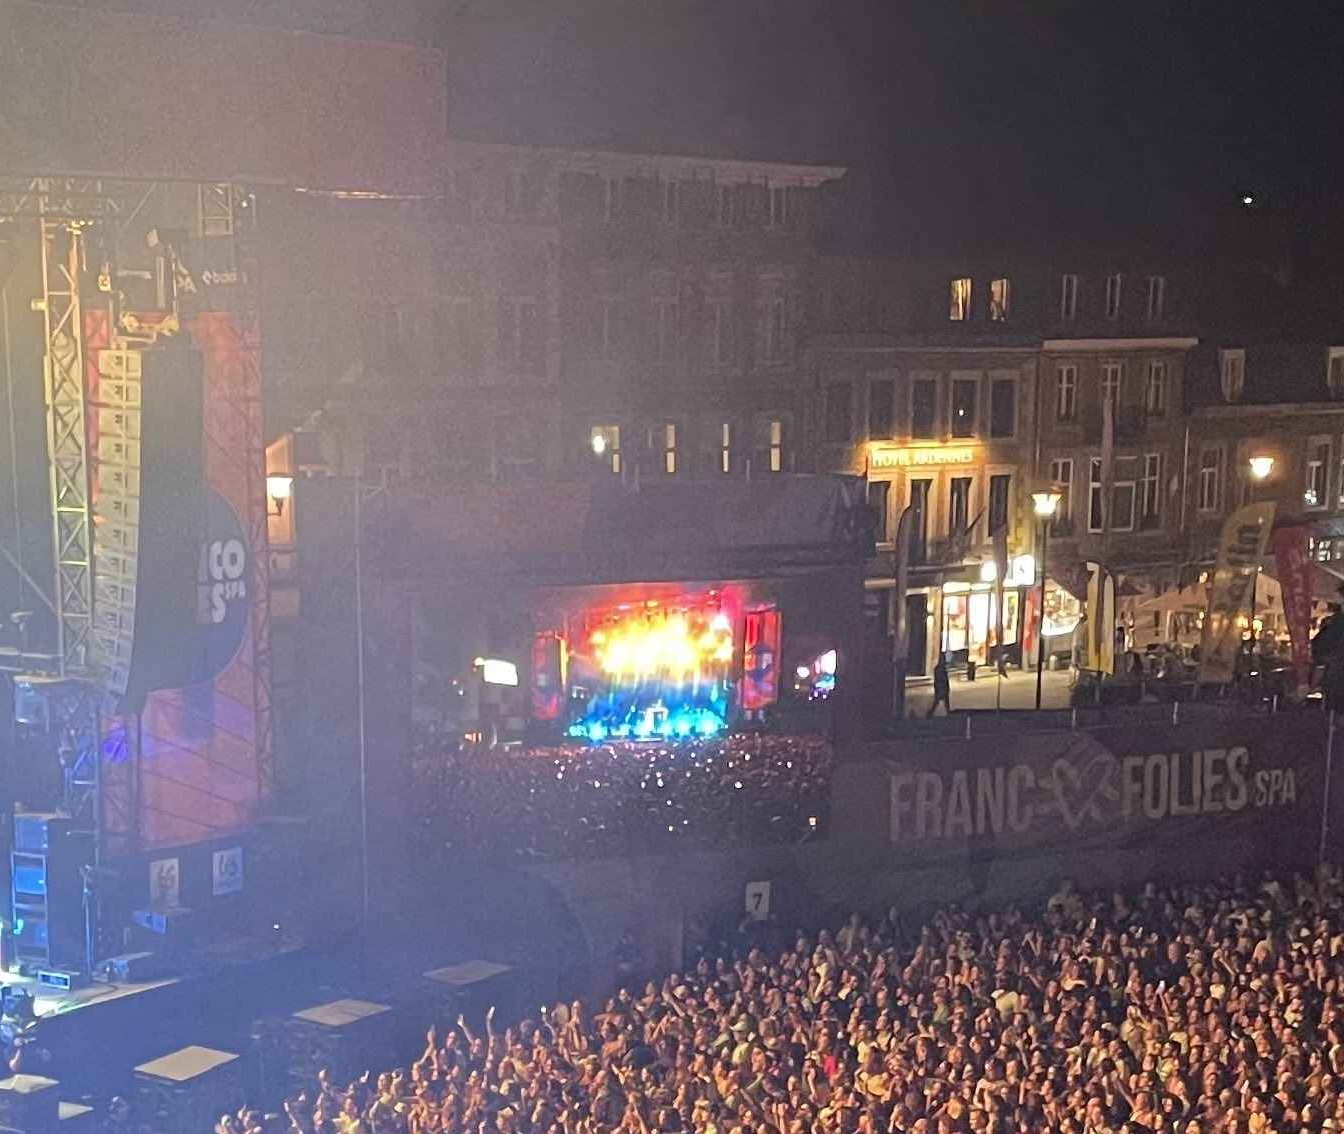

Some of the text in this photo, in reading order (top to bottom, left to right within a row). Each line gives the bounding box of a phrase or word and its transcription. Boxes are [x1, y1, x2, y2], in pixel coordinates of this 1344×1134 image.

[889, 747, 1297, 842] FRANC FOLIES SPA
